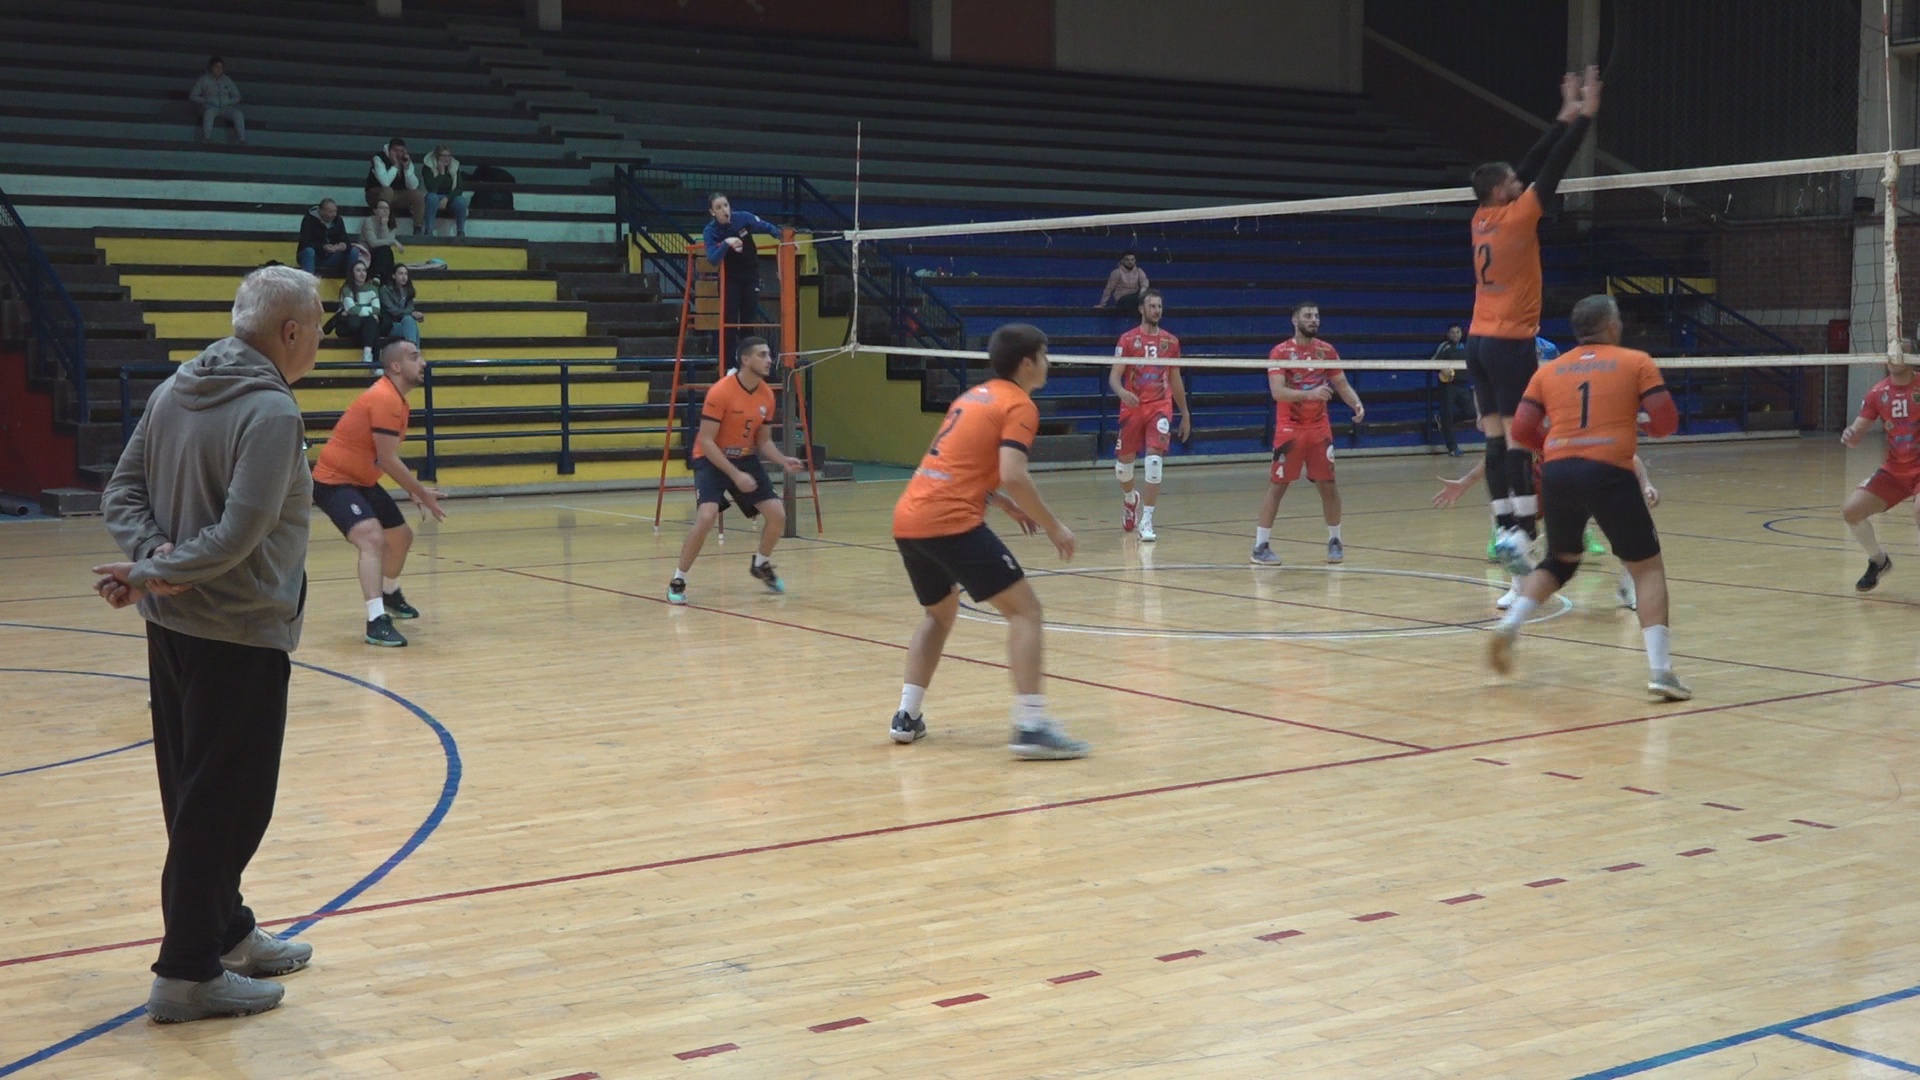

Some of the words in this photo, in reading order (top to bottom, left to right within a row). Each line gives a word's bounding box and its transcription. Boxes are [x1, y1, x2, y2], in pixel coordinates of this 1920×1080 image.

[1144, 345, 1157, 359] 13
[1576, 380, 1590, 429] 1
[1891, 399, 1908, 418] 21
[743, 420, 753, 438] 5
[1276, 466, 1285, 478] 4
